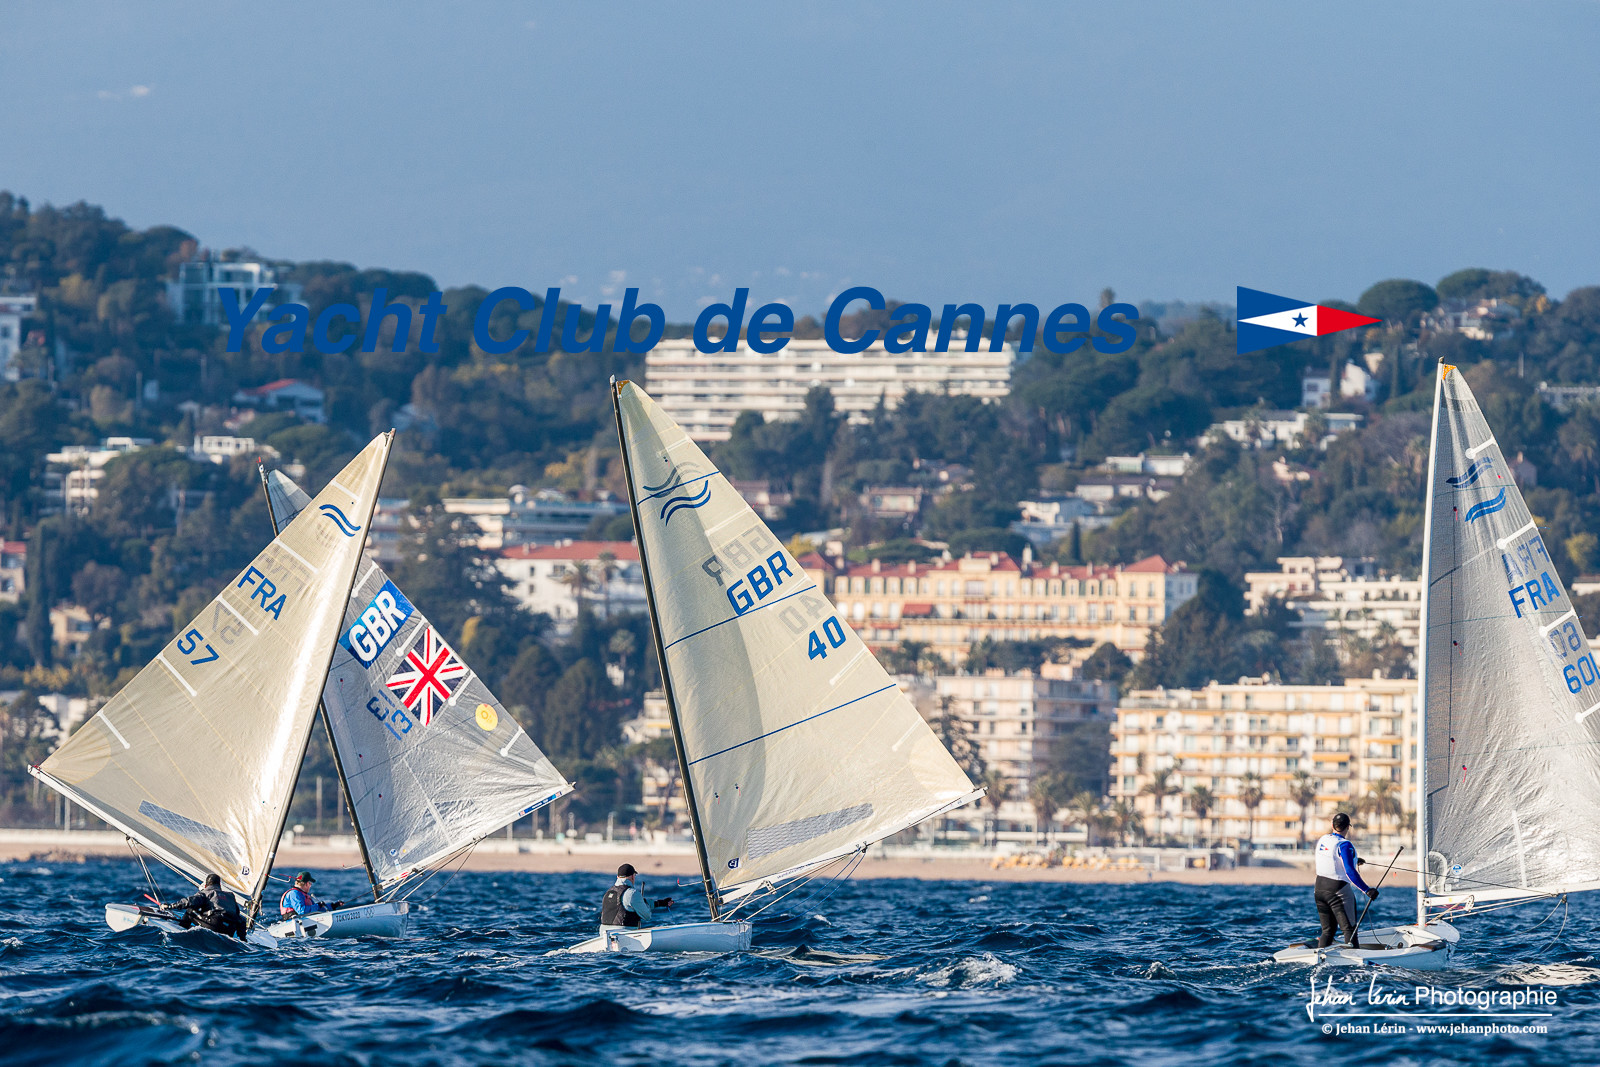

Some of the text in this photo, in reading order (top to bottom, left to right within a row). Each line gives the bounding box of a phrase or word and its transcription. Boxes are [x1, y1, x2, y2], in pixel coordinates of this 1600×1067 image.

[237, 566, 287, 620] FRA
[727, 551, 793, 616] GBR
[1508, 571, 1560, 619] FRA
[177, 629, 220, 665] 57
[349, 590, 406, 662] GBR
[808, 615, 846, 660] 40
